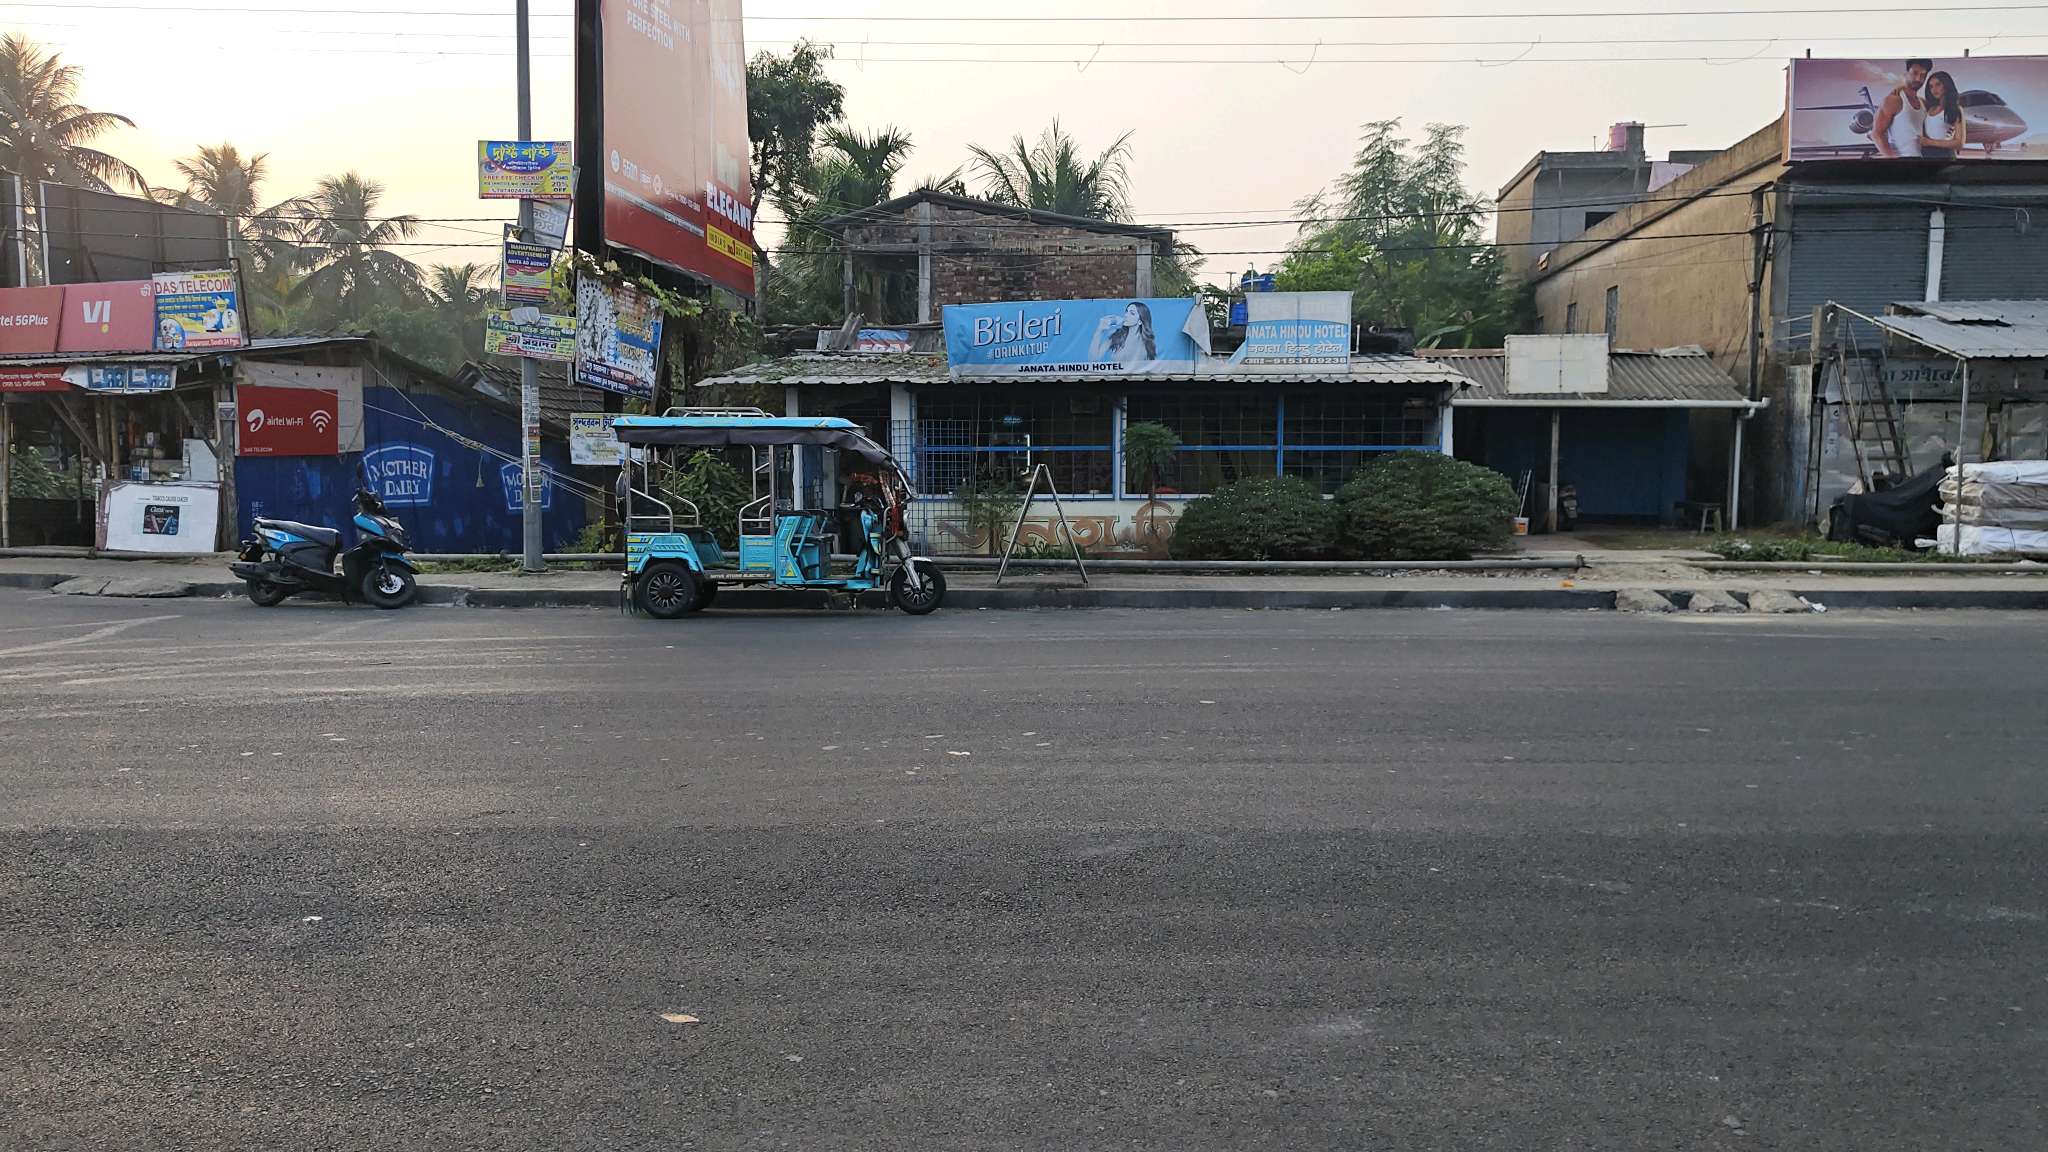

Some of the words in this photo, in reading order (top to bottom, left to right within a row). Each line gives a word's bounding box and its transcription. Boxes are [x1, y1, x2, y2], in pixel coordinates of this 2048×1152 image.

[627, 9, 673, 49] PERFECTION
[706, 181, 751, 232] ELEGANT
[507, 249, 550, 259] ADVERTISEMENT
[154, 281, 177, 294] DAS
[179, 279, 231, 293] TELECOM
[972, 306, 1063, 347] Bisleri
[1246, 325, 1277, 338] ANATA
[1280, 324, 1312, 338] HINDU
[1314, 324, 1346, 338] HOTEL
[1018, 364, 1056, 373] JANATA
[1058, 363, 1090, 372] HINDU
[1092, 362, 1124, 371] HOTEL
[266, 415, 285, 426] airtel
[285, 417, 304, 426] Wi-Fi
[369, 459, 427, 482] MOTHER
[384, 478, 421, 497] DAIRY
